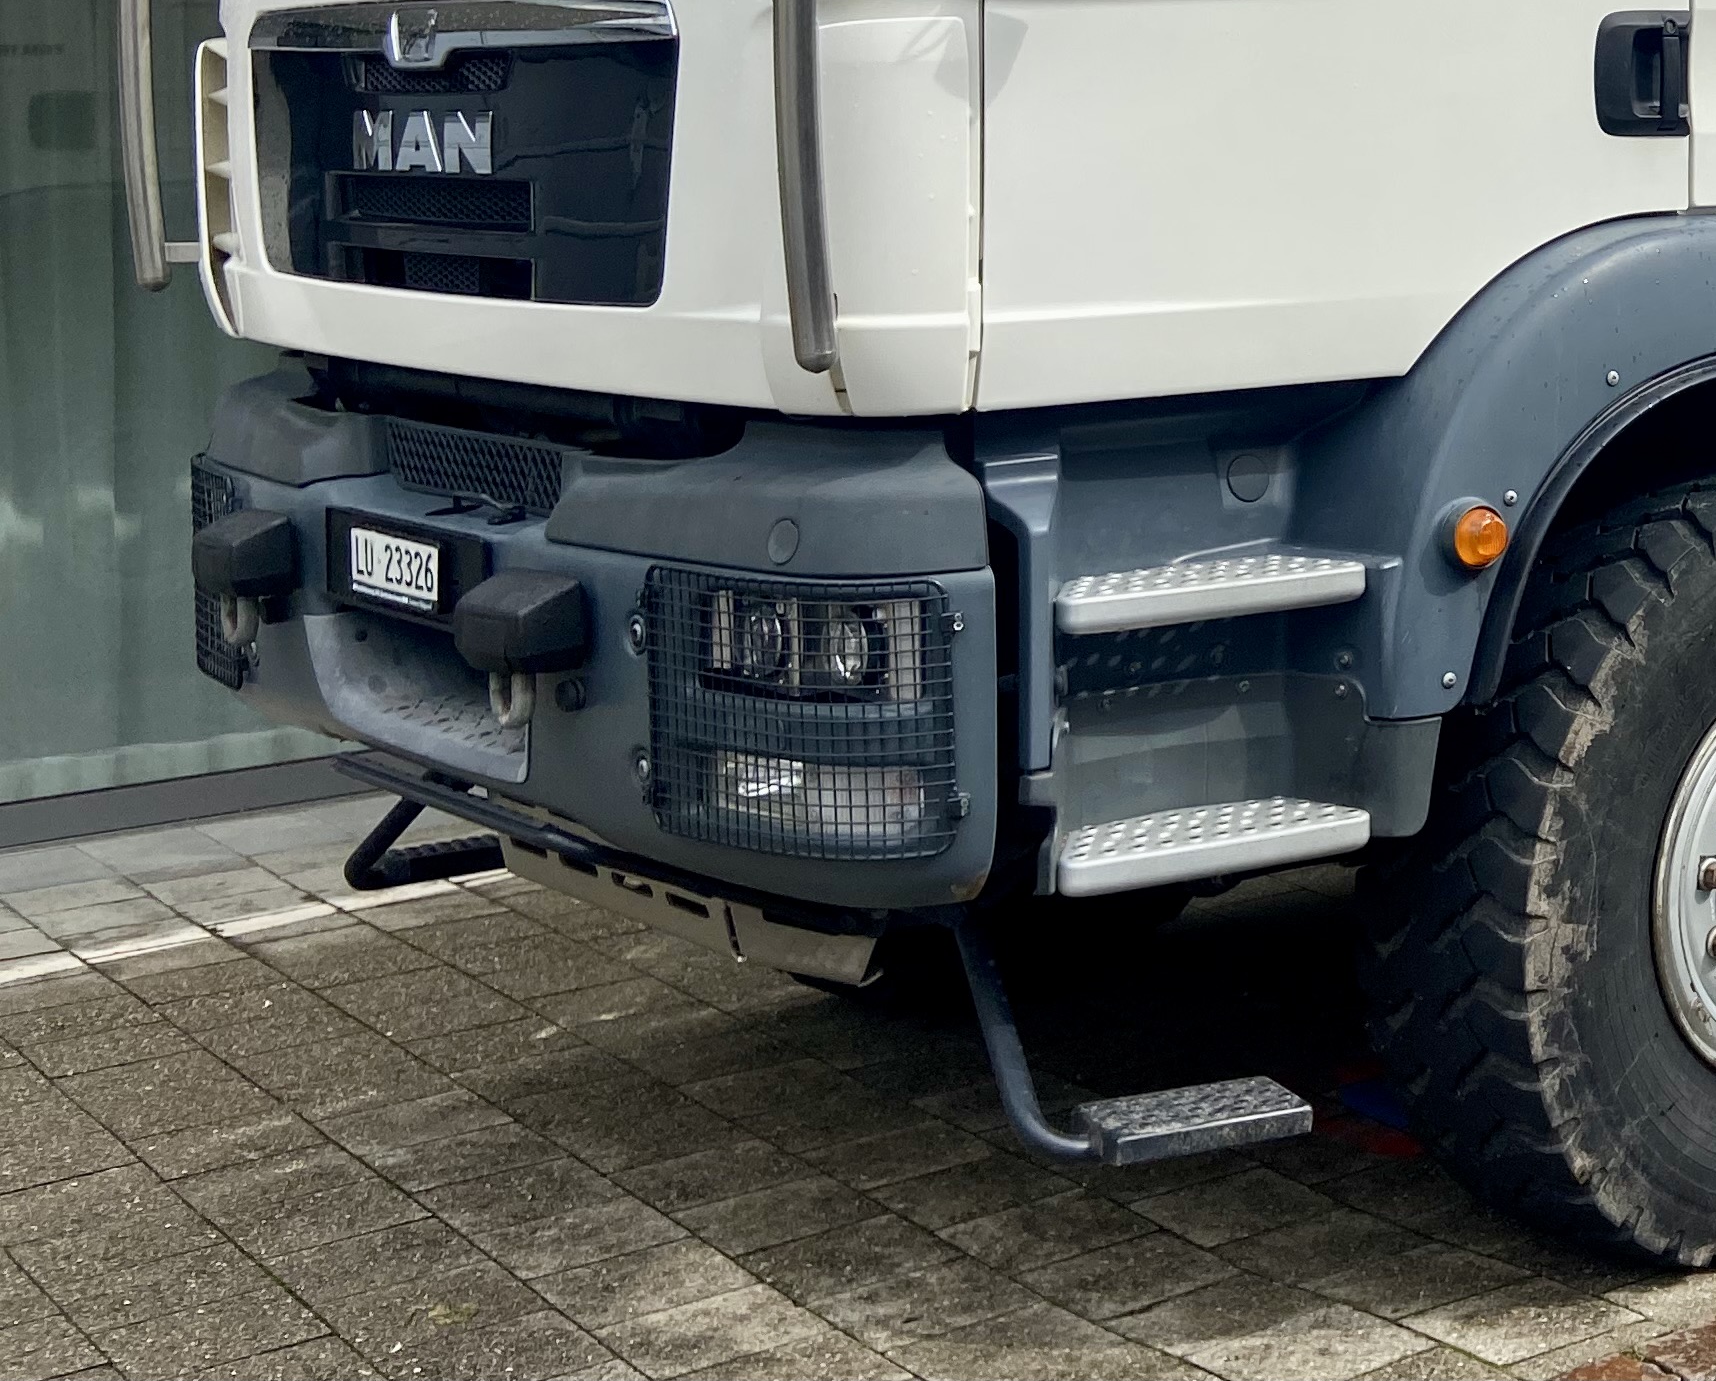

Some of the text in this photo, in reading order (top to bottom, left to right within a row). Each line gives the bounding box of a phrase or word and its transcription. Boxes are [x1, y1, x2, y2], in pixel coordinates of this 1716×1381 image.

[353, 109, 493, 174] MAN
[355, 535, 434, 593] LU 23326
